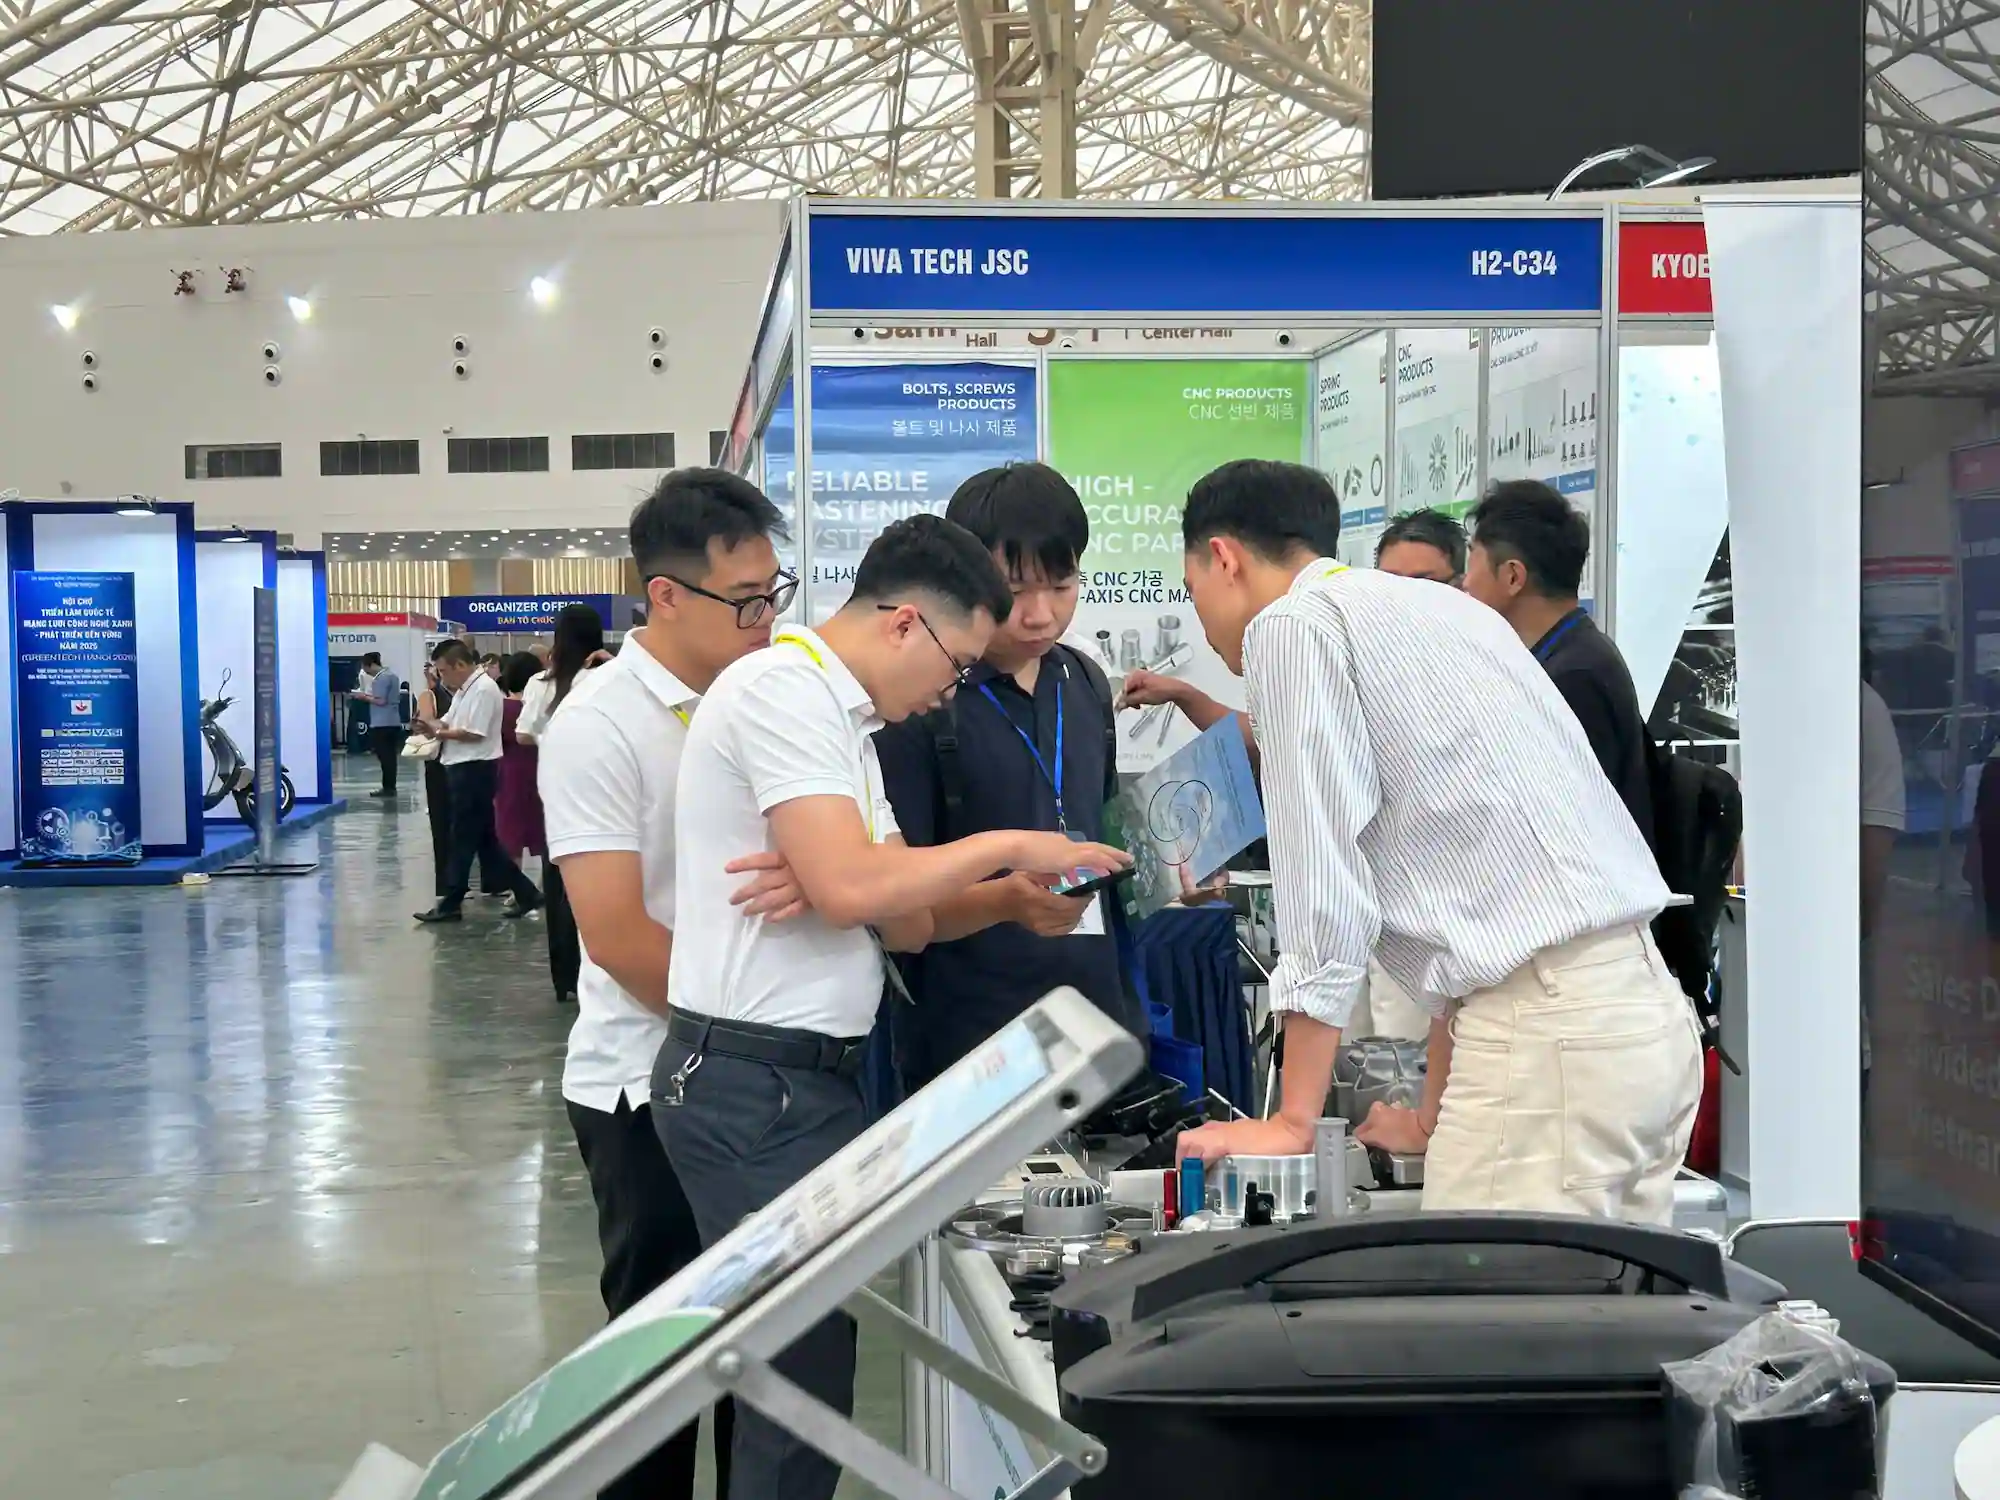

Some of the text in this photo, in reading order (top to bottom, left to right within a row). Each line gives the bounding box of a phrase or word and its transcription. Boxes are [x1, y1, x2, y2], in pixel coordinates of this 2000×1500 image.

[846, 247, 1029, 276] VIVA TECH JSC
[1471, 250, 1557, 276] H2-C34
[1651, 253, 1711, 279] KYOE
[966, 332, 998, 348] Hall
[1142, 327, 1195, 340] Center
[1398, 343, 1412, 363] CNC
[1398, 357, 1434, 386] PRODUCTS
[902, 383, 1016, 397] BOLTS, SCREWS
[1182, 388, 1293, 399] CNC PRODUCTS
[937, 398, 1016, 410] PRODUCTS
[1189, 404, 1224, 420] CNC
[928, 419, 943, 437] 및
[949, 419, 981, 437] 나사
[984, 419, 1017, 437] 제품
[1085, 503, 1184, 525] CCURA
[1085, 532, 1123, 554] NC
[1093, 572, 1128, 587] CNC
[1132, 570, 1164, 588] 가공
[1080, 588, 1194, 604] -AXIS CNC MA
[468, 600, 584, 612] ORGANIZER OFFI
[1979, 975, 2000, 1022] D
